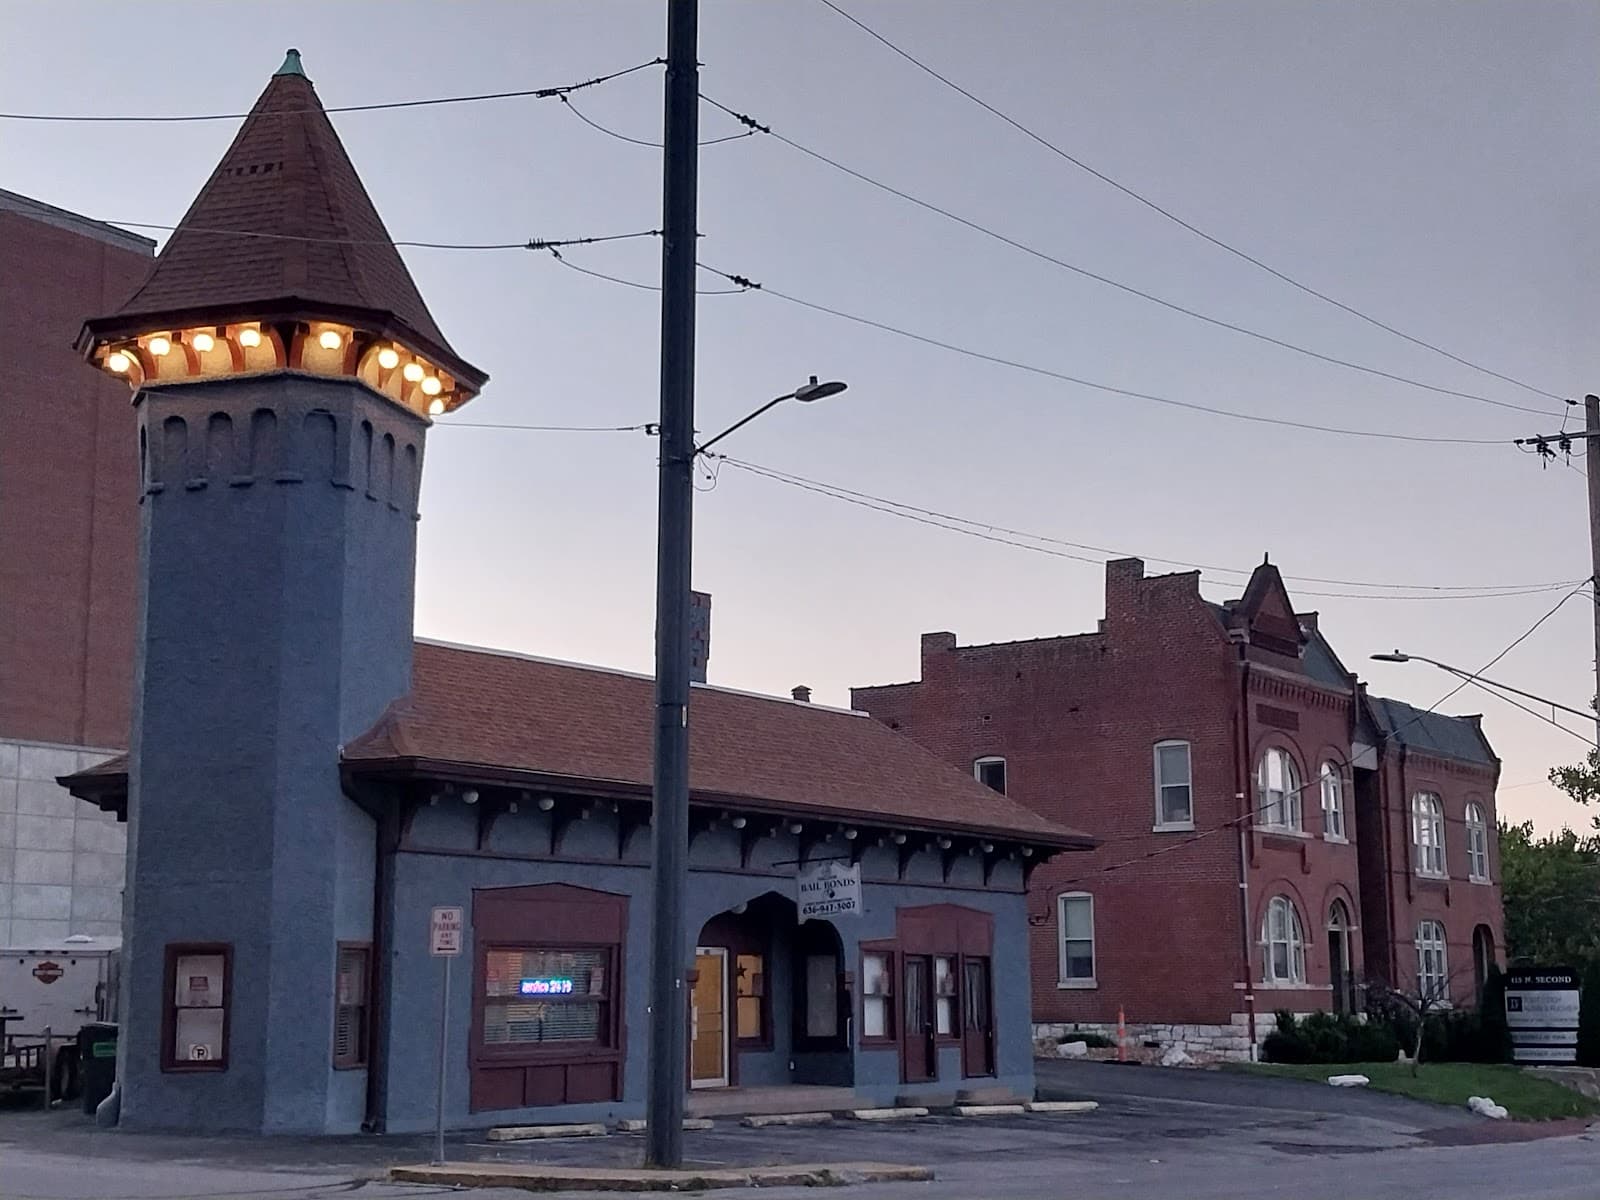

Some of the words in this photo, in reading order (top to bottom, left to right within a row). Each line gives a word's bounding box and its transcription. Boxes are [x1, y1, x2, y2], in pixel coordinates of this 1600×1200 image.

[801, 881, 821, 892] BAIL
[823, 879, 856, 889] BONDS
[441, 911, 454, 921] NO
[433, 921, 461, 931] PARKING
[1535, 974, 1572, 984] SECOND
